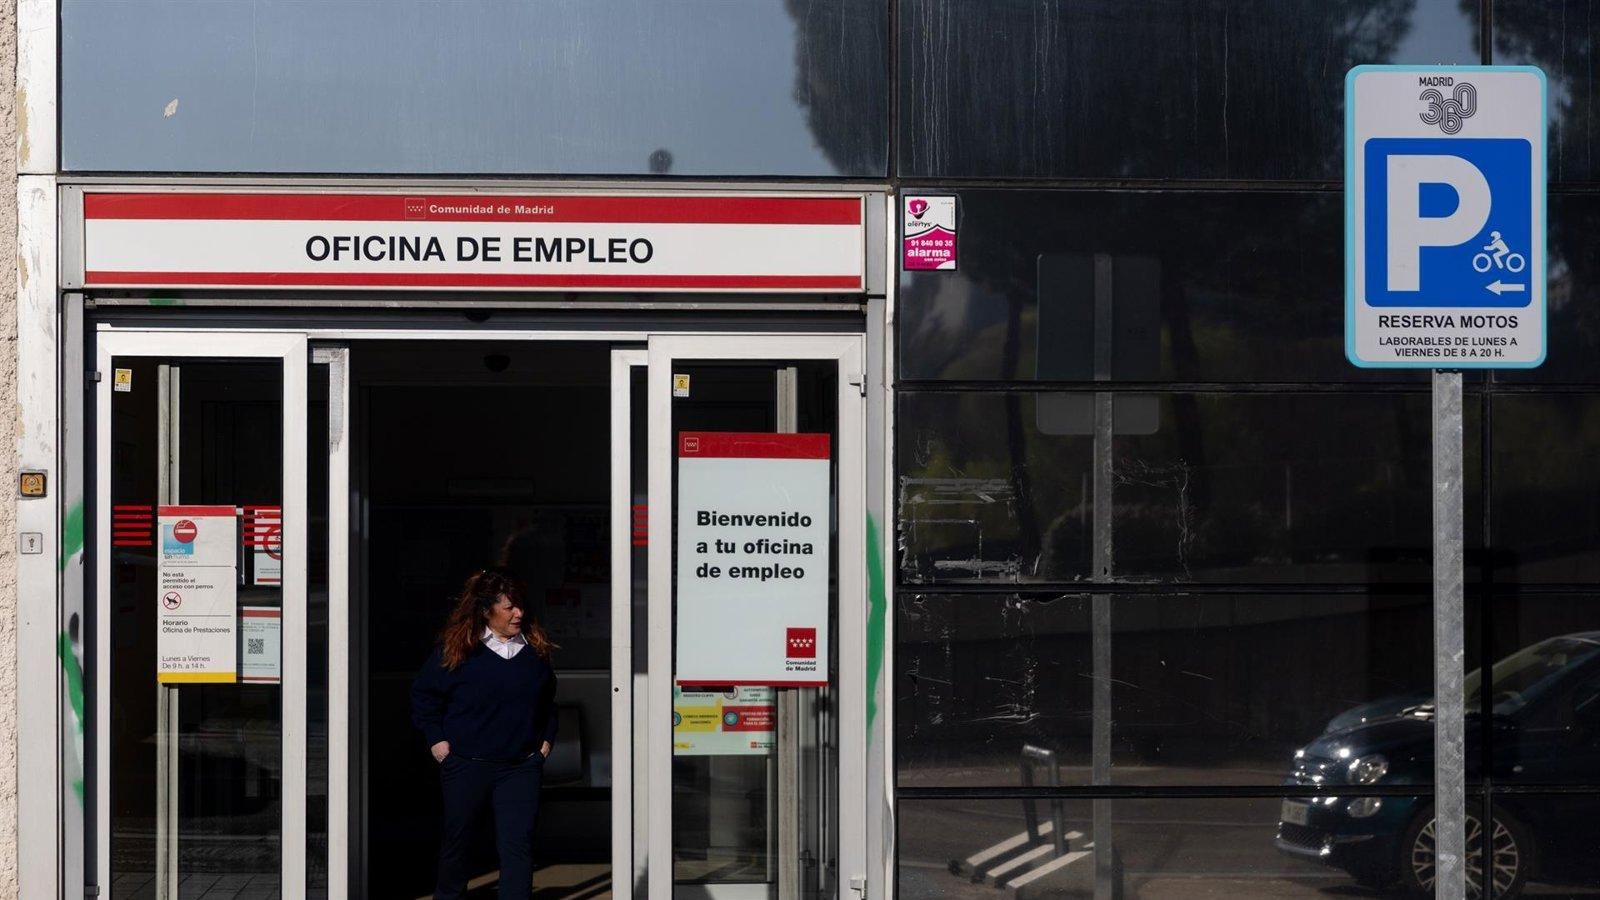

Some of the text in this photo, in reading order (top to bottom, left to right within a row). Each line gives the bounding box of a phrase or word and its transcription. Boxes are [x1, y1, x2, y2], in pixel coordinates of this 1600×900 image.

[1419, 76, 1453, 87] MADRID
[1419, 82, 1477, 135] 360
[429, 204, 554, 215] Comunidad de Madrid
[1387, 154, 1492, 291] P
[305, 235, 654, 264] OFICINA DE EMPLEO
[907, 248, 951, 257] alarma
[1378, 315, 1519, 329] RESERVA MOTOS
[1379, 337, 1518, 346] LABORABLES DE LUNES A
[1394, 348, 1505, 358] VIERNES DE 8 A 20 H.
[696, 510, 812, 528] Bienvenido
[696, 538, 813, 555] a tu oficina
[696, 562, 805, 582] de empleo
